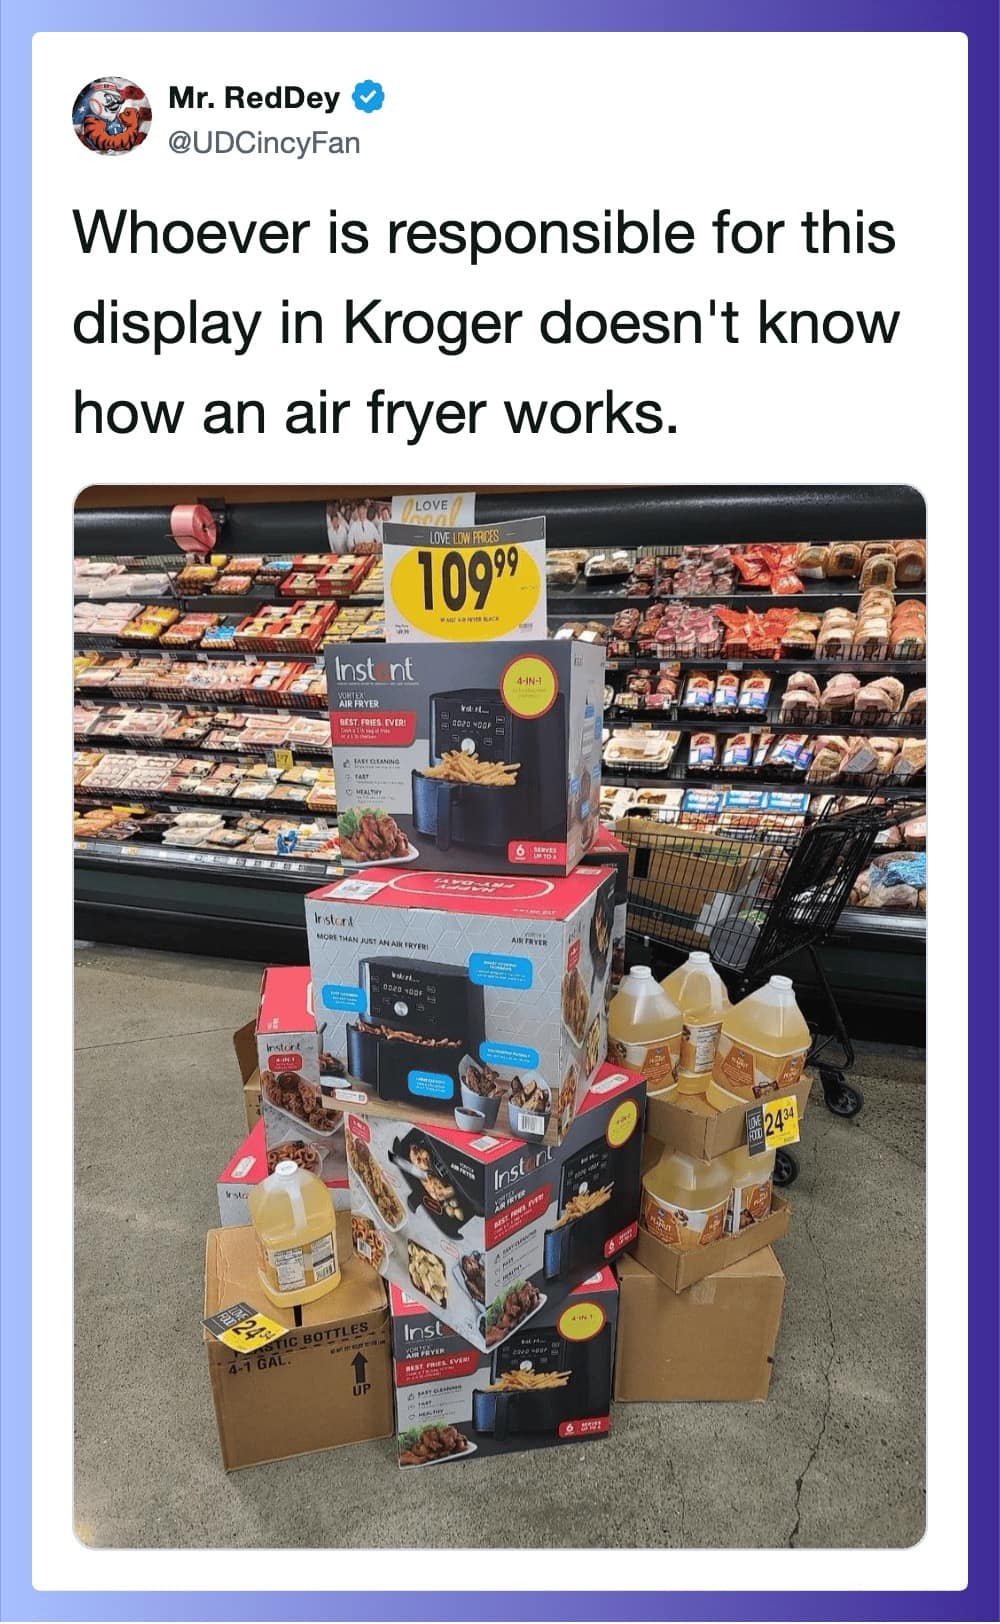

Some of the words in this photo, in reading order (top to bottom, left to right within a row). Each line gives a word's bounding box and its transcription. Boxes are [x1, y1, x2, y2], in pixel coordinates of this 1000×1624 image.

[415, 500, 448, 511] LOVE
[430, 531, 450, 545] LOVE
[453, 531, 471, 545] LOW
[473, 529, 500, 544] PRICES
[335, 655, 414, 682] Instant
[517, 676, 542, 686] 4-IN-1
[339, 700, 353, 708] AIR
[354, 700, 379, 708] FRYER
[385, 718, 407, 728] EVER!
[516, 844, 525, 857] 6
[436, 884, 497, 893] HAPPY
[314, 911, 354, 927] Instant
[316, 933, 338, 941] MORE
[340, 935, 358, 943] THAN
[360, 937, 377, 945] JUST
[379, 939, 390, 947] AN
[525, 938, 548, 946] FRYER
[749, 1115, 762, 1129] LOVE
[749, 1128, 763, 1142] FOOD
[495, 1145, 553, 1191] Instant
[404, 1320, 450, 1341] Inst
[234, 1336, 298, 1358] ASTIC
[304, 1321, 369, 1345] BOTTLES
[406, 1351, 419, 1359] AIR
[421, 1348, 445, 1358] FRYER
[228, 1361, 251, 1376] 4-1
[257, 1355, 292, 1371] GAL.
[352, 1383, 371, 1397] UP
[566, 1423, 574, 1433] 6
